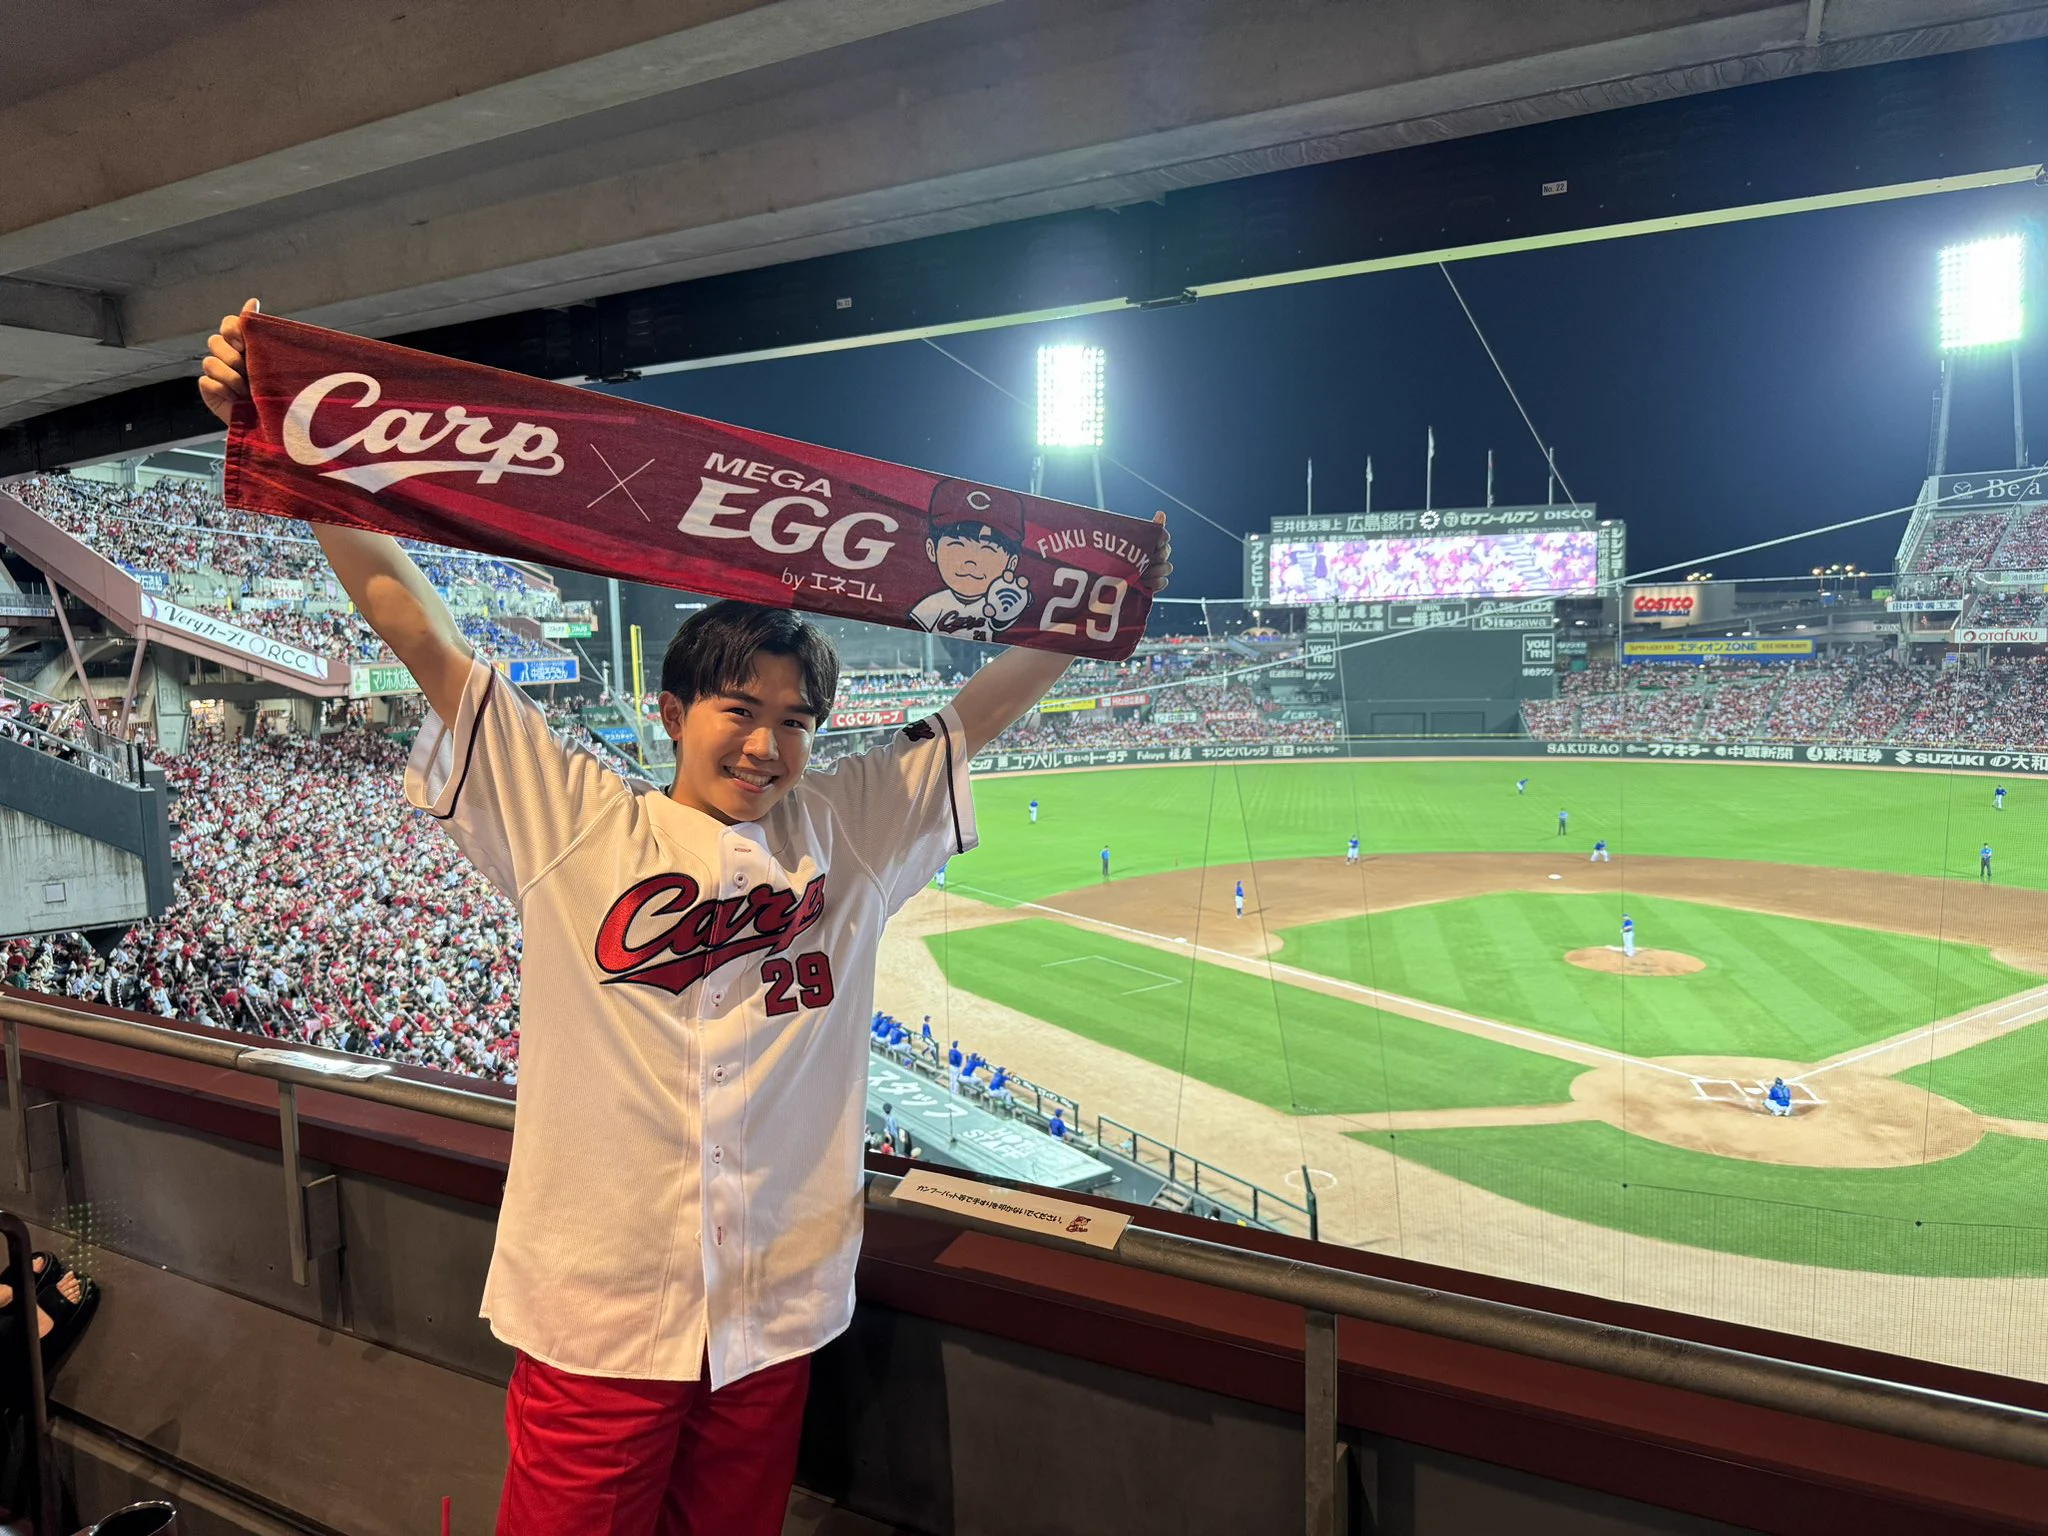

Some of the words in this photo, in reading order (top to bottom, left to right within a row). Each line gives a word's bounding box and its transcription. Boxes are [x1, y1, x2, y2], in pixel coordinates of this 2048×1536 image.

[282, 372, 565, 494] Carp
[704, 452, 832, 498] MEGA
[1986, 479, 2020, 498] Be
[966, 490, 991, 511] C
[677, 476, 899, 570] EGG
[1272, 518, 1343, 533] 三井住友海上
[1346, 512, 1417, 532] 広島銀行
[1544, 509, 1593, 521] DISCO
[1037, 529, 1087, 559] FUKU
[781, 567, 805, 589] by
[810, 572, 883, 602] エネコム
[1039, 567, 1128, 642] 29
[1634, 595, 1694, 611] COSTCO
[1526, 640, 1550, 652] you
[1530, 648, 1551, 658] me
[1726, 642, 1757, 651] ZONE
[268, 645, 309, 669] RCC
[836, 711, 900, 727] CGCグループ
[1547, 743, 1619, 755] SAKURAO
[1823, 748, 1883, 763] 東洋証券
[1915, 752, 1985, 766] SUZUKI
[1012, 752, 1061, 769] ユウベル
[2011, 754, 2048, 771] 大和
[594, 872, 826, 996] Carp
[760, 950, 835, 1018] 29
[868, 1062, 968, 1118] スタッフ
